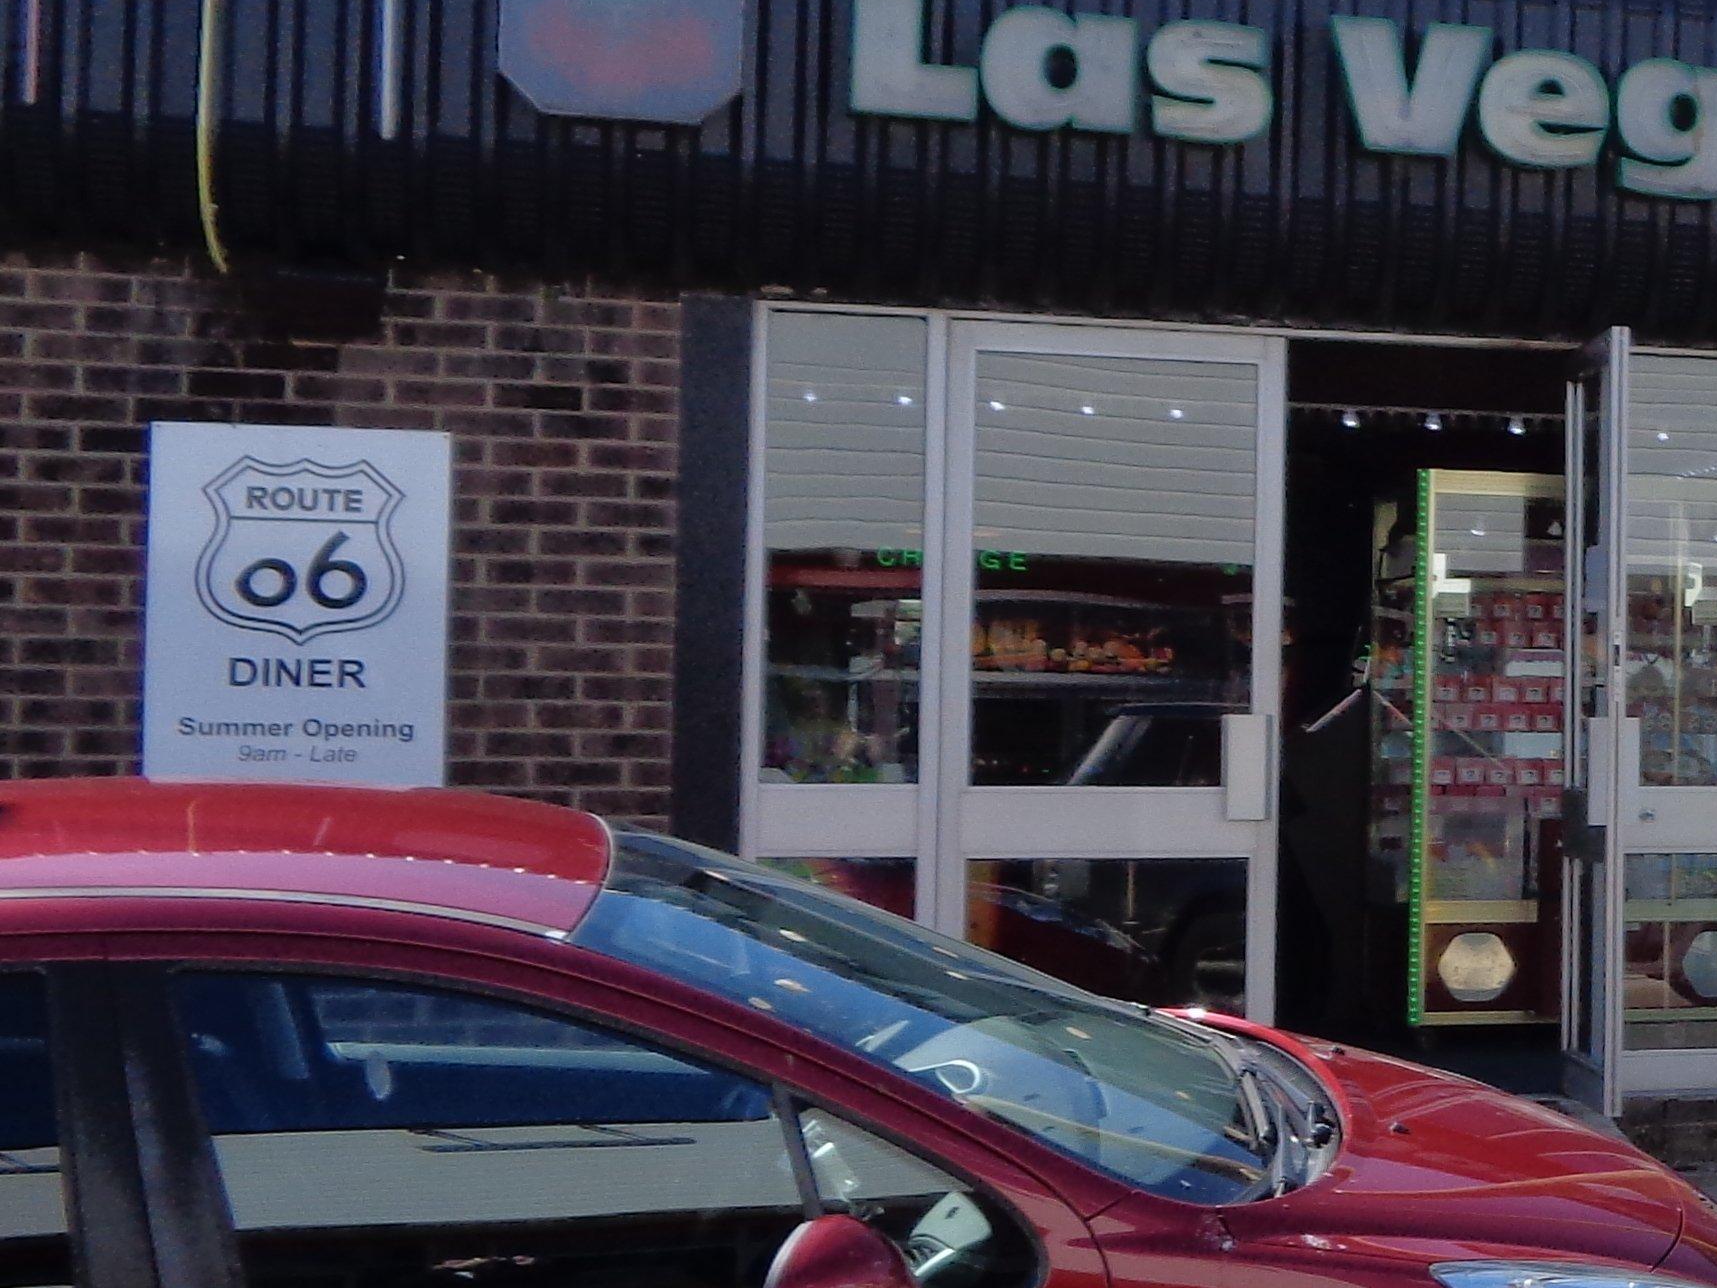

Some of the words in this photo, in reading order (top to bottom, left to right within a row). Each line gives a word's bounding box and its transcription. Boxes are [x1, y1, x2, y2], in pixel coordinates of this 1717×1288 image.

[245, 485, 364, 513] ROUTE
[877, 545, 1027, 571] CHGE
[229, 657, 366, 689] DINER
[178, 717, 293, 738] Summer
[302, 718, 416, 743] Opening
[237, 745, 286, 763] 9am
[310, 745, 358, 763] Late
